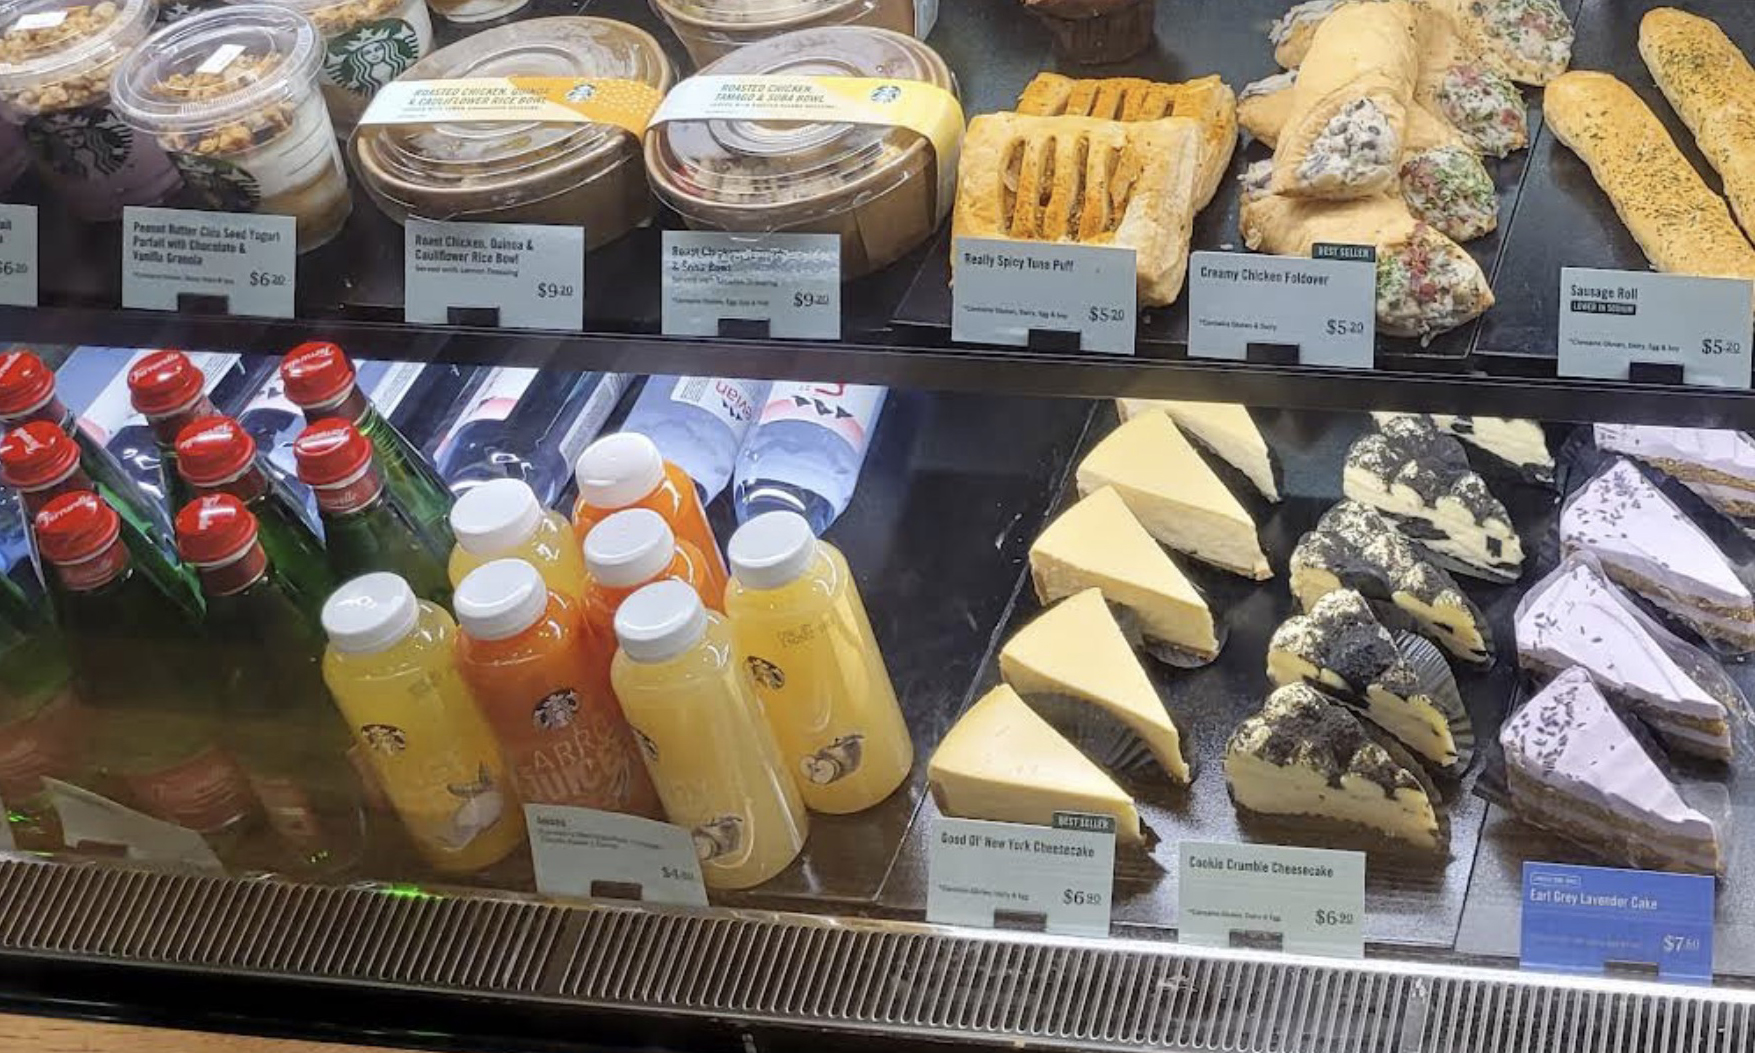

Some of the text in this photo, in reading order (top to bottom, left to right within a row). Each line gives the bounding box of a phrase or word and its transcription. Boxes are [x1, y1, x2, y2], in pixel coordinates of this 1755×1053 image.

[415, 249, 519, 265] Cauliflower Rice Bowl
[1318, 245, 1370, 258] BEST SELLER
[1201, 266, 1329, 287] Creamy Chicken Foldover
[537, 282, 573, 299] $9.20
[1571, 284, 1637, 301] Sausage Roll
[1326, 318, 1364, 336] $5.20
[1189, 855, 1334, 879] Cookie Crumble Cheesecake
[1314, 909, 1354, 927] $6.90
